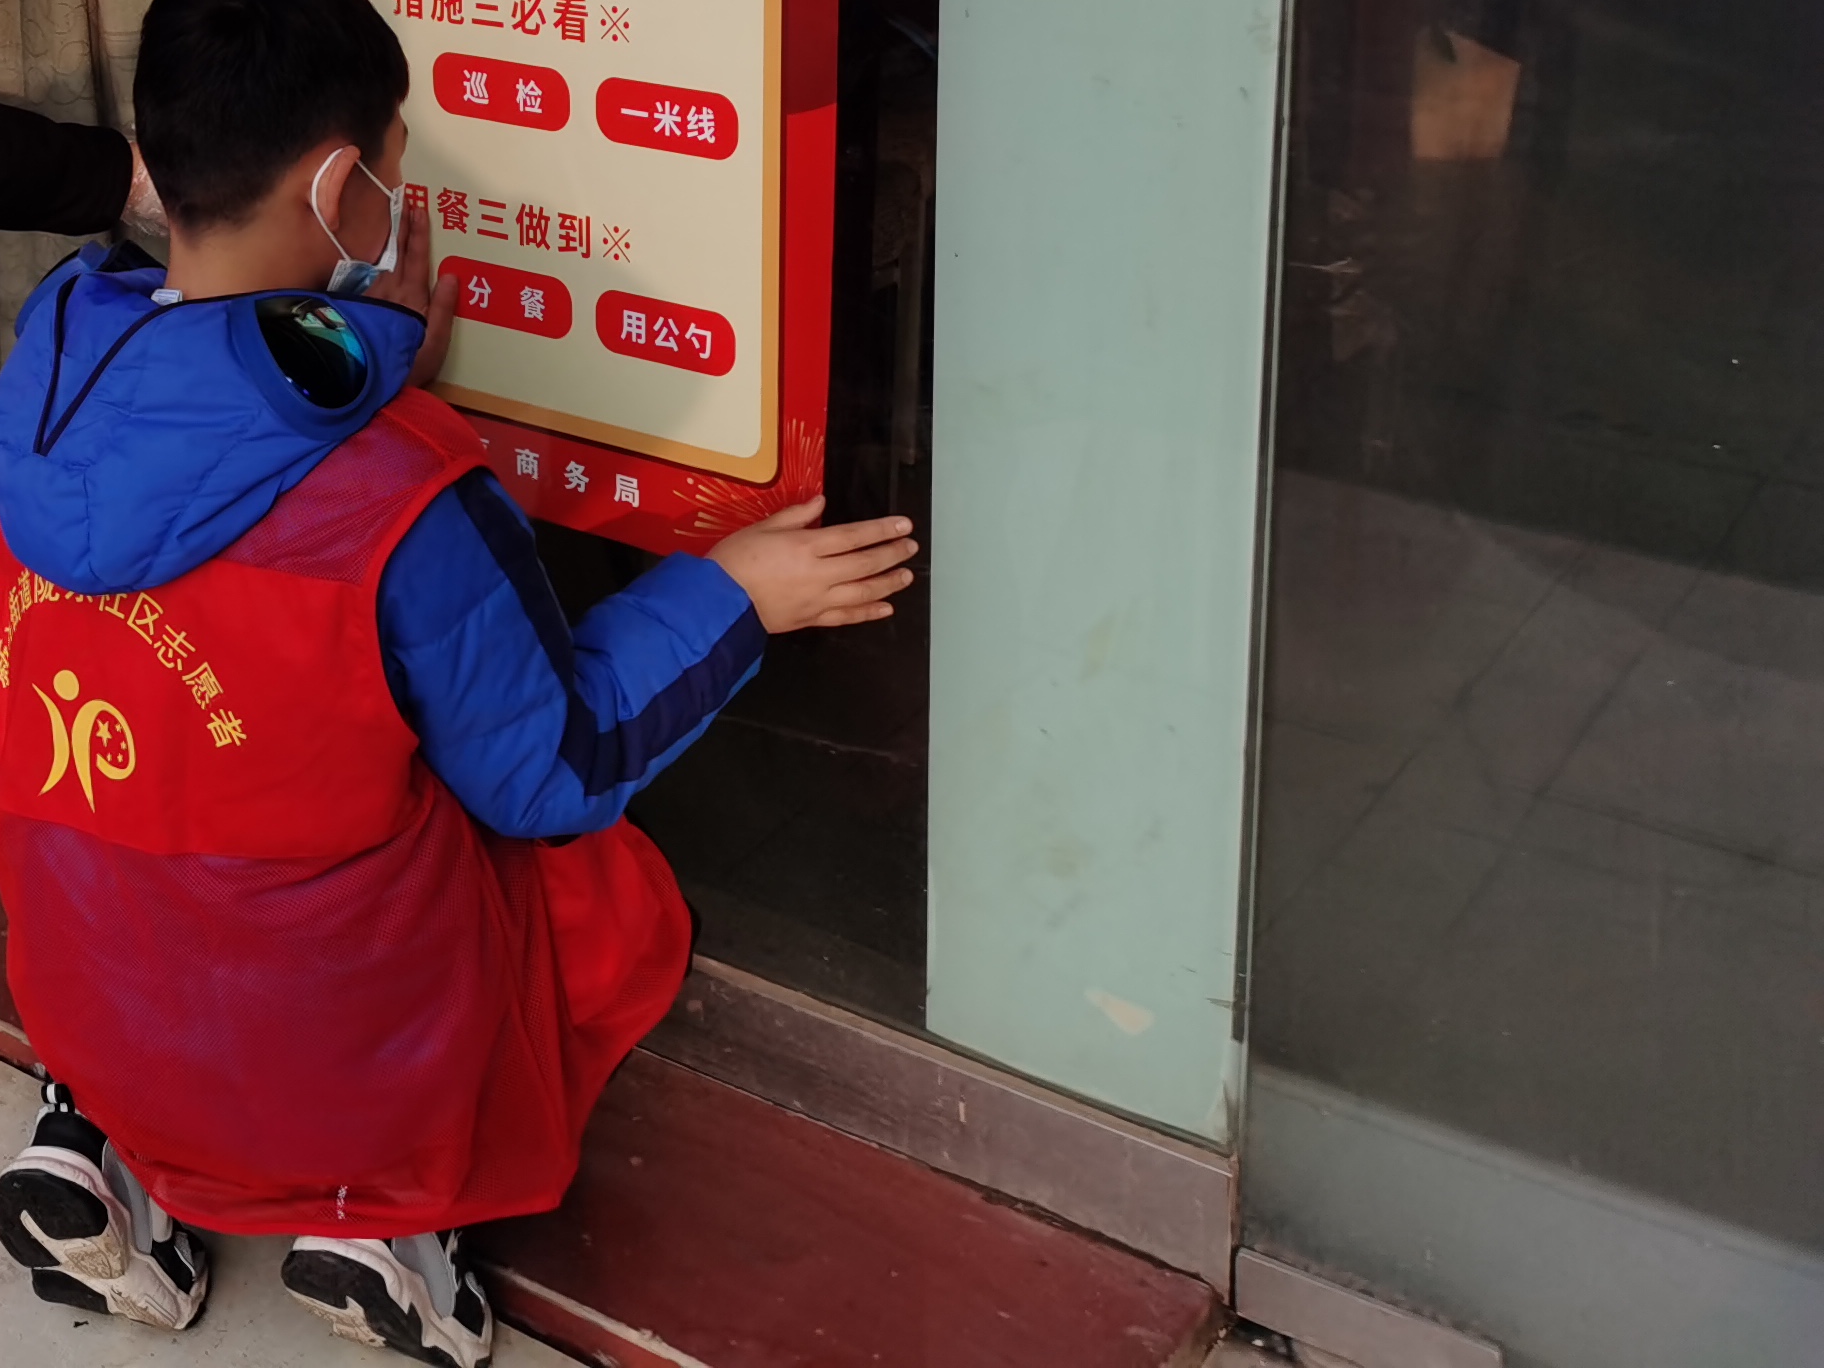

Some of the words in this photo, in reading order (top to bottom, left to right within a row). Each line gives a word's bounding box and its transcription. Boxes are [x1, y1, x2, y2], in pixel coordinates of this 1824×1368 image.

[462, 68, 544, 117] 巡检
[619, 98, 718, 147] 一米线
[466, 275, 547, 323] 分餐
[620, 308, 713, 360] 用公勺
[479, 437, 641, 508] 商务局
